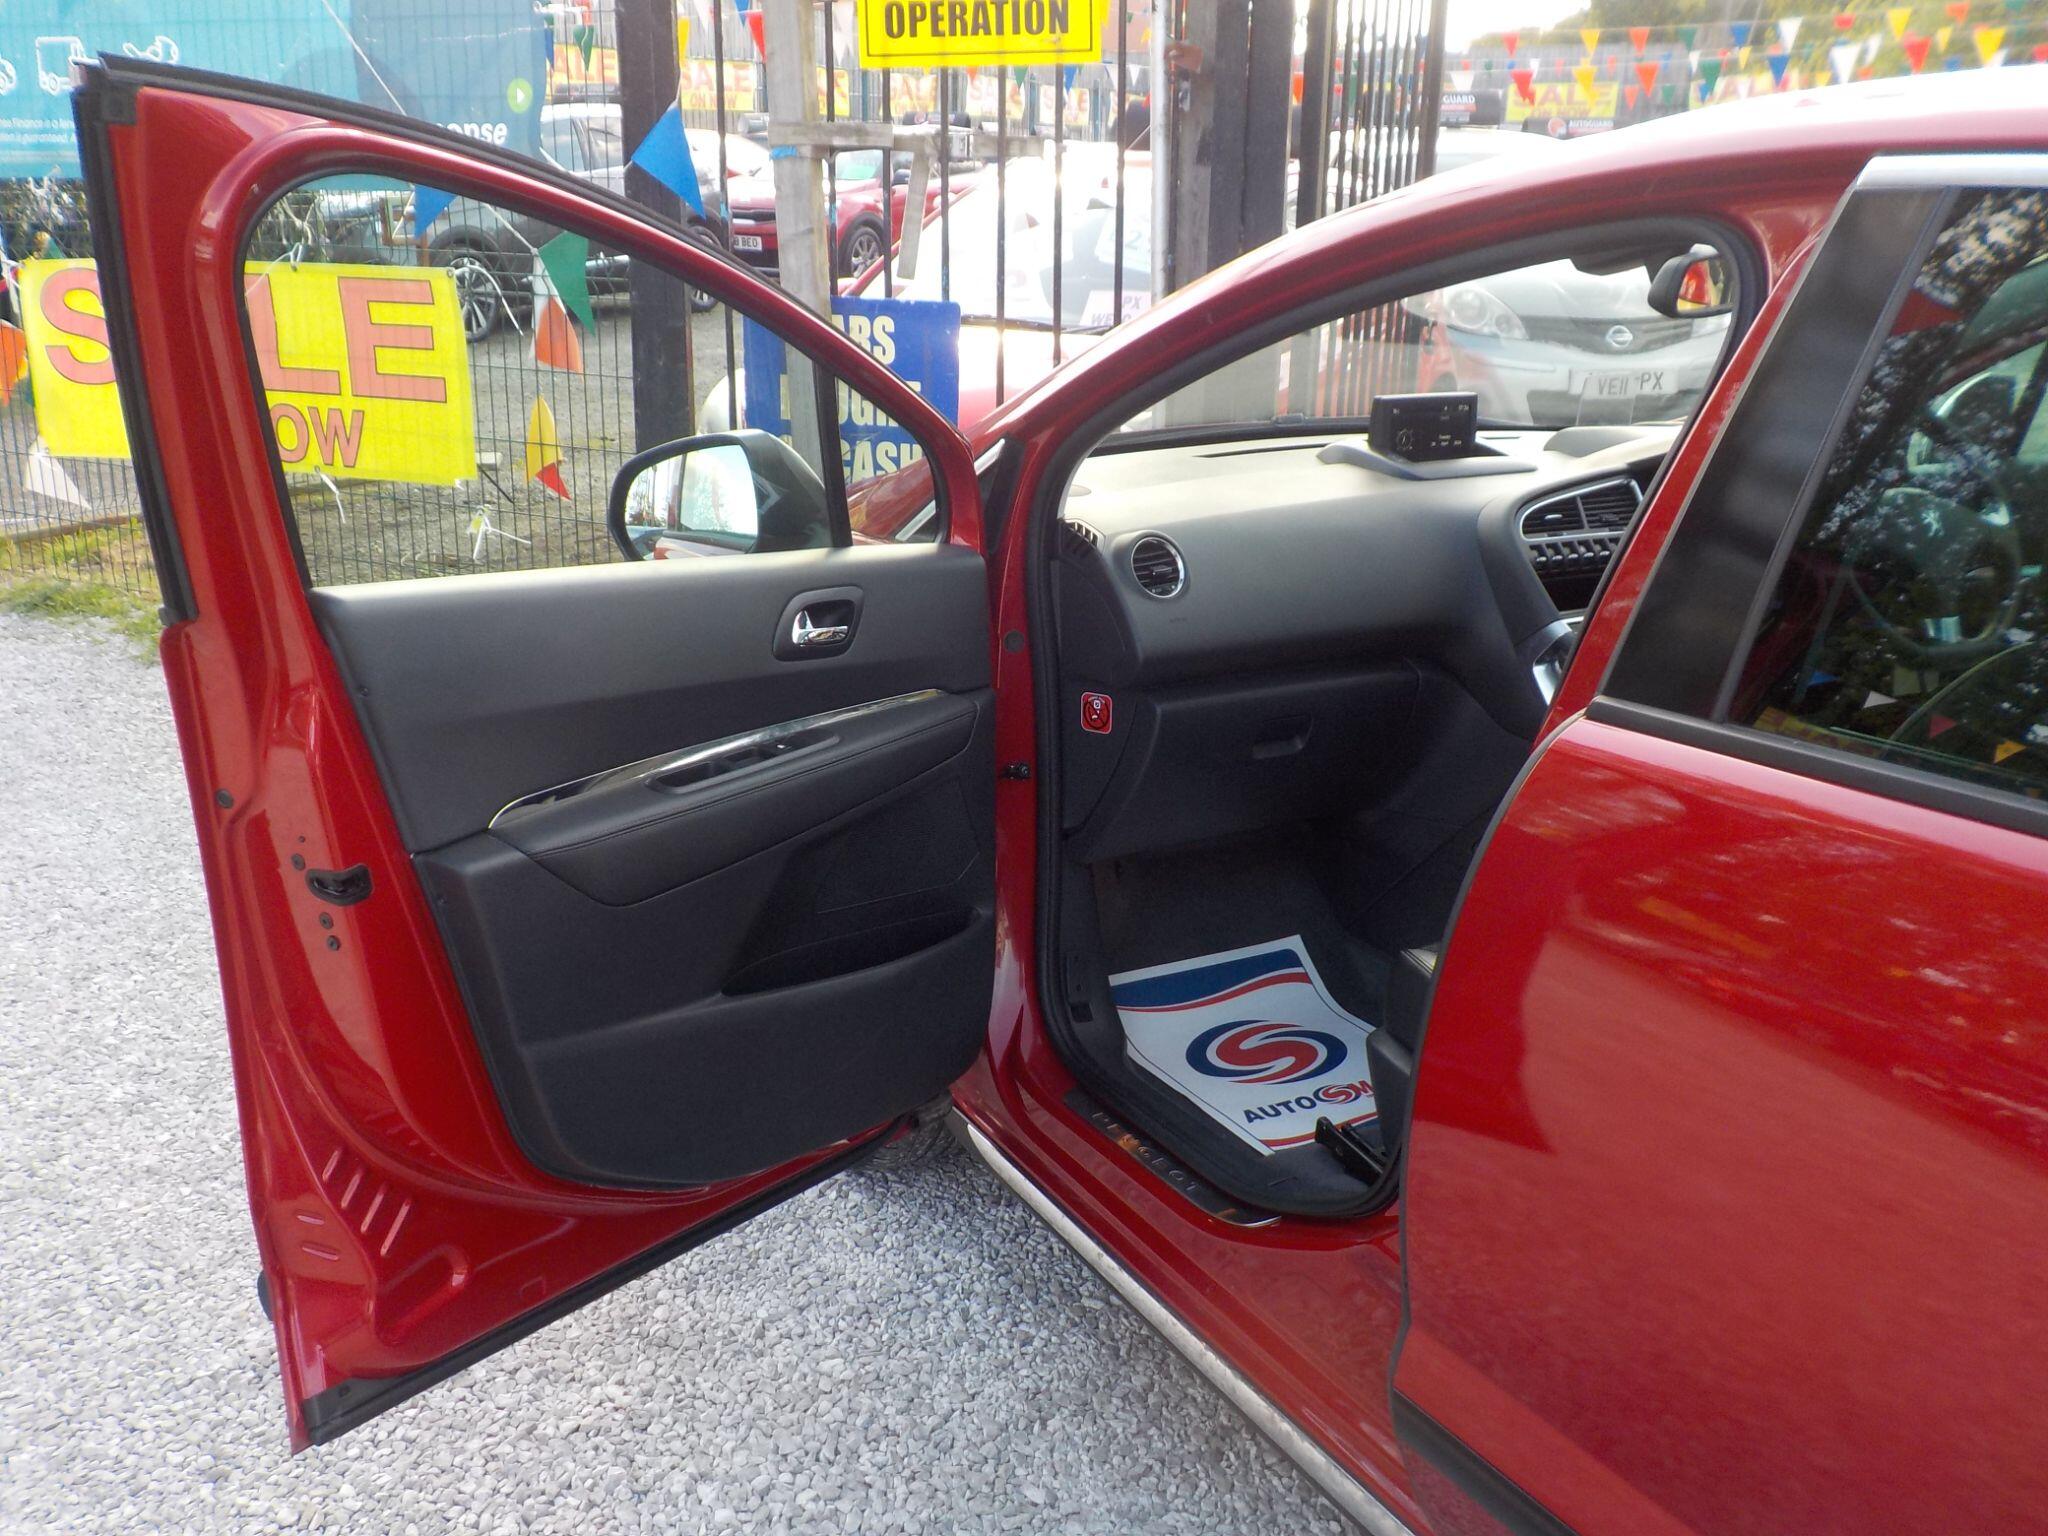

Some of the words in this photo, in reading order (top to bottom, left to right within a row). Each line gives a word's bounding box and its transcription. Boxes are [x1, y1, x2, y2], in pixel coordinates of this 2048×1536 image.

[884, 0, 1069, 38] OPERATION
[40, 266, 447, 404] SLE
[274, 403, 365, 468] OW
